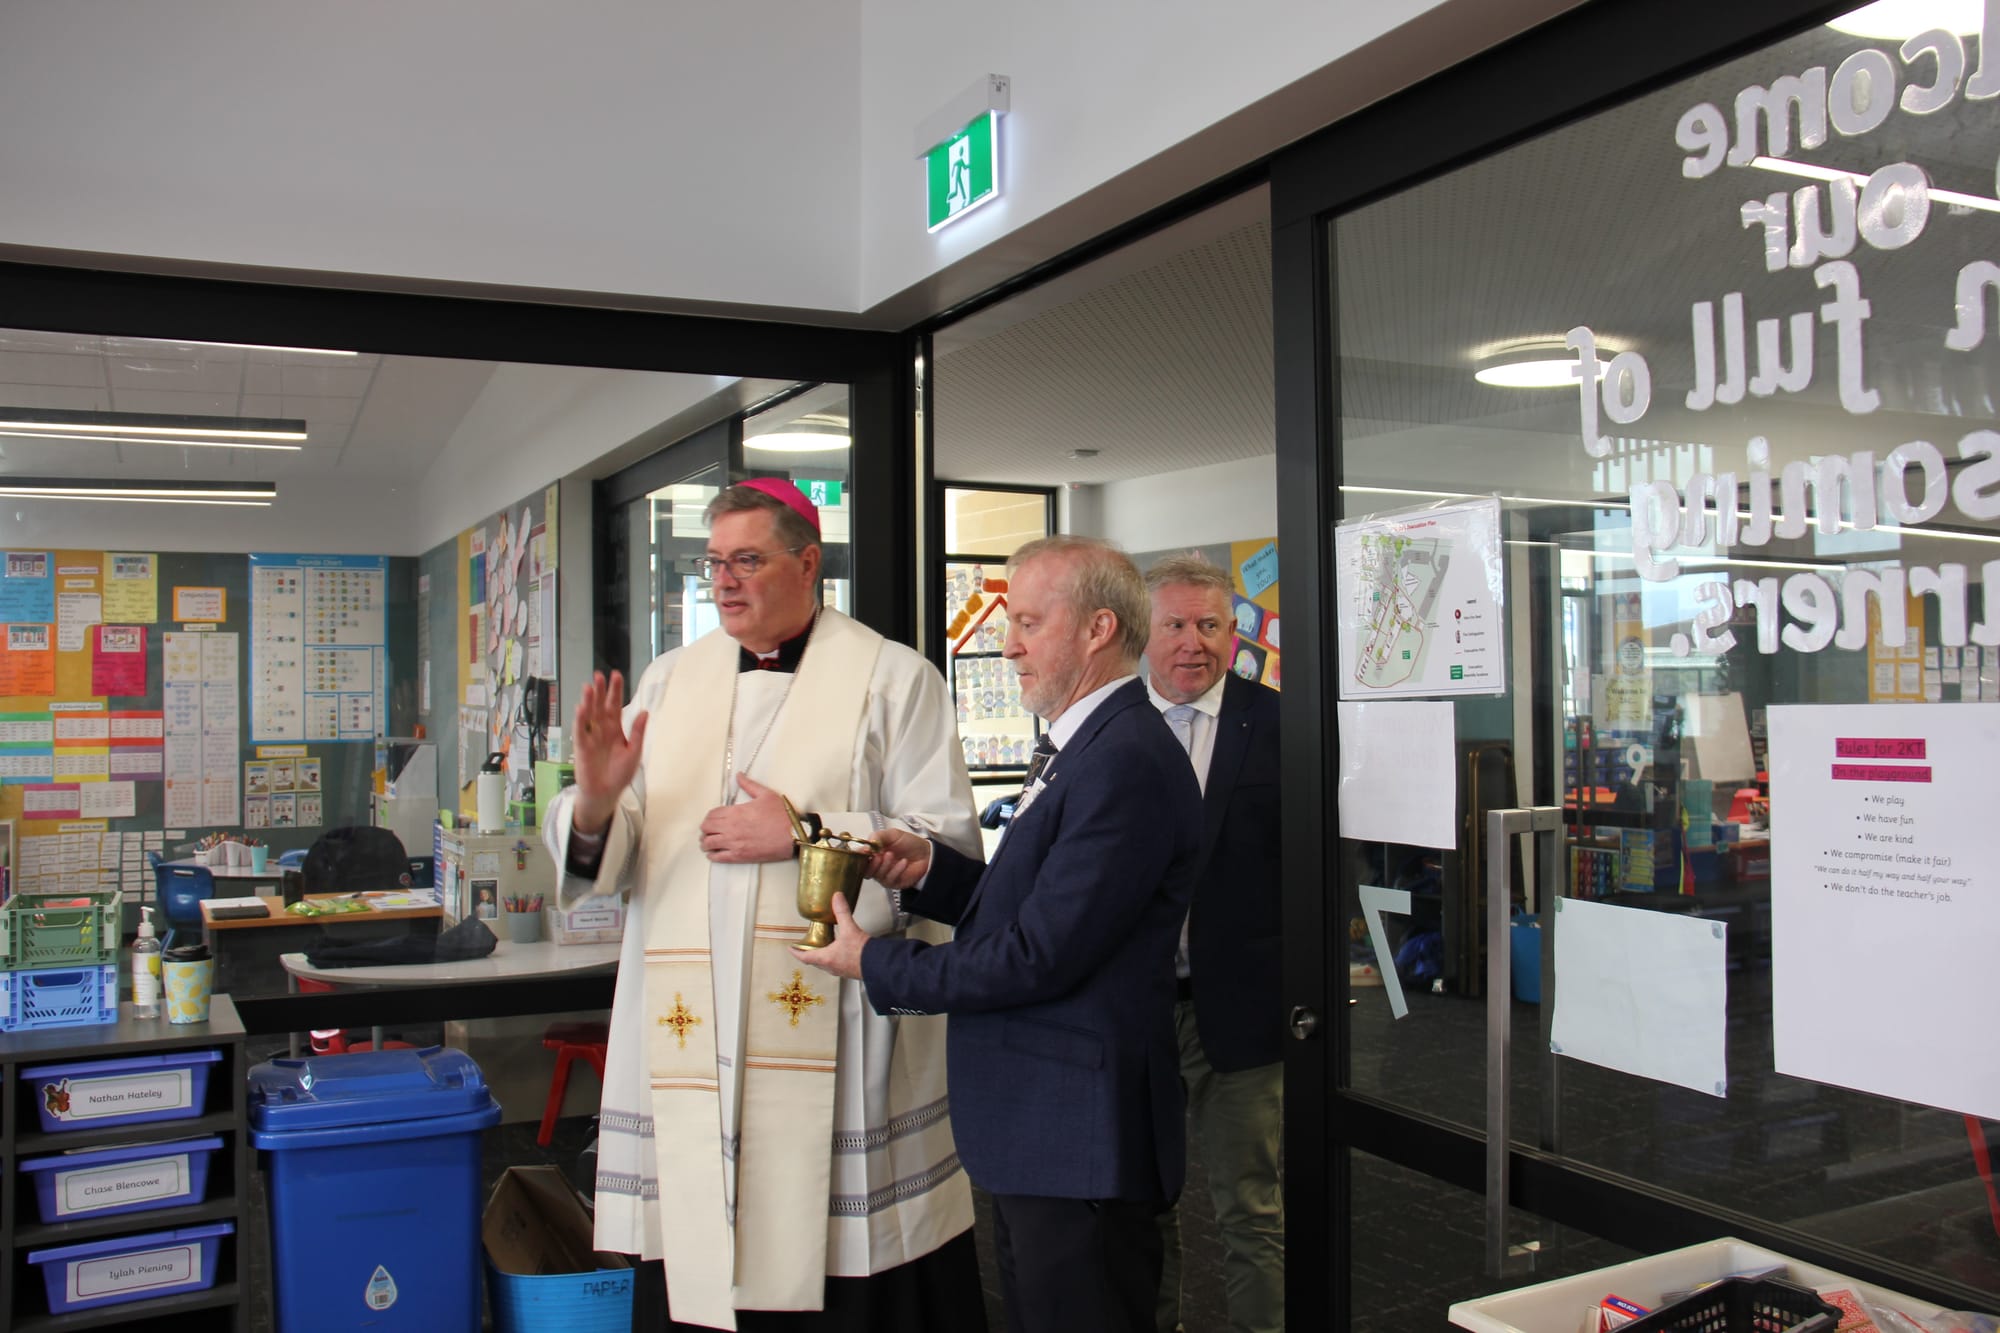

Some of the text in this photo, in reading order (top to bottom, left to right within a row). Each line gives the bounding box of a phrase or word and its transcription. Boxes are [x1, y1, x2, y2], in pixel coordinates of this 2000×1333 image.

[1837, 741, 1869, 755] Rules
[1873, 740, 1892, 758] for
[1871, 794, 1905, 807] We play
[1863, 812, 1914, 826] We have fun
[1864, 832, 1914, 844] We are kind
[1830, 849, 1843, 858] We
[1844, 851, 1893, 863] compromise
[1895, 854, 1922, 865] (make
[1923, 855, 1931, 865] it
[1840, 867, 1850, 875] do
[1858, 868, 1873, 878] half
[1872, 871, 1884, 879] my
[1885, 872, 1900, 882] way
[1901, 872, 1916, 881] and
[1916, 873, 1932, 883] half
[1830, 881, 1843, 891] We
[1844, 884, 1867, 893] don't
[1868, 886, 1879, 895] do
[1880, 886, 1895, 897] the
[1896, 888, 1935, 901] teacher's
[89, 1089, 163, 1104] Nathan Hateley
[84, 1177, 160, 1196] Chase Blencowe
[137, 1263, 174, 1275] Piening
